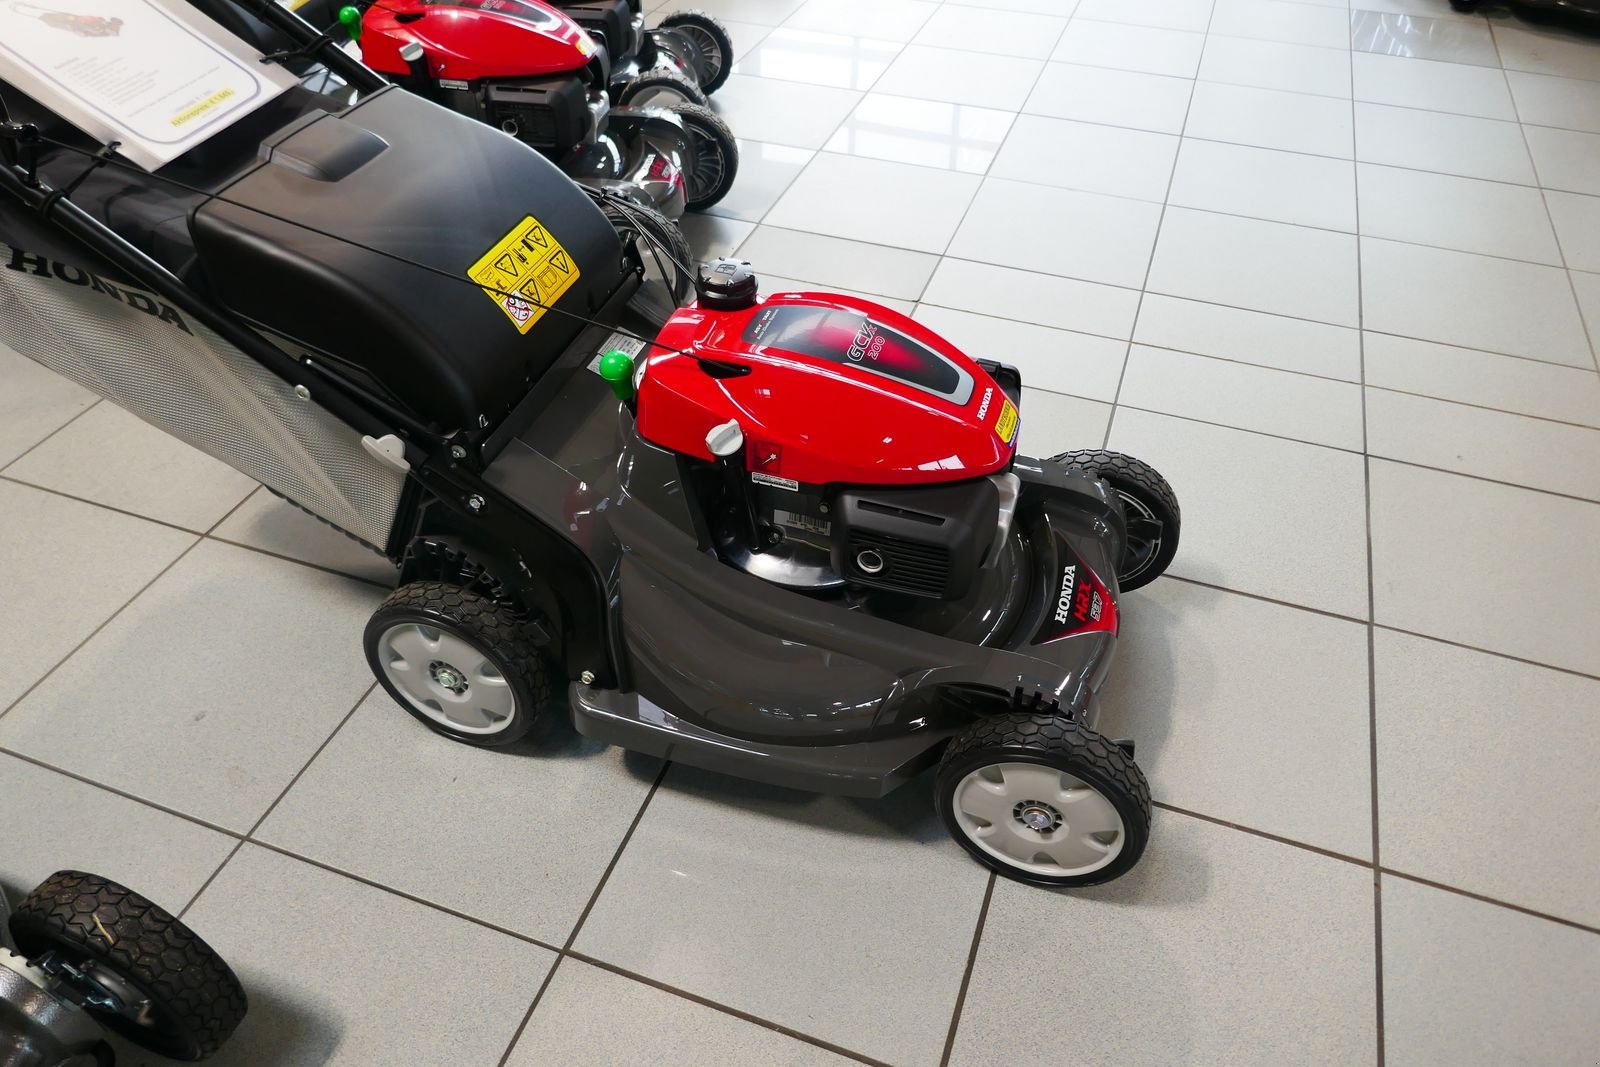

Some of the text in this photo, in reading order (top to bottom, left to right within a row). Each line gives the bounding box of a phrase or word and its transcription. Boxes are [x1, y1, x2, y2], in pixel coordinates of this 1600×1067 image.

[6, 245, 194, 336] HONDA
[867, 336, 886, 361] 200
[977, 388, 993, 421] HONDA
[1055, 565, 1076, 624] HONDA
[1074, 578, 1091, 622] HRX
